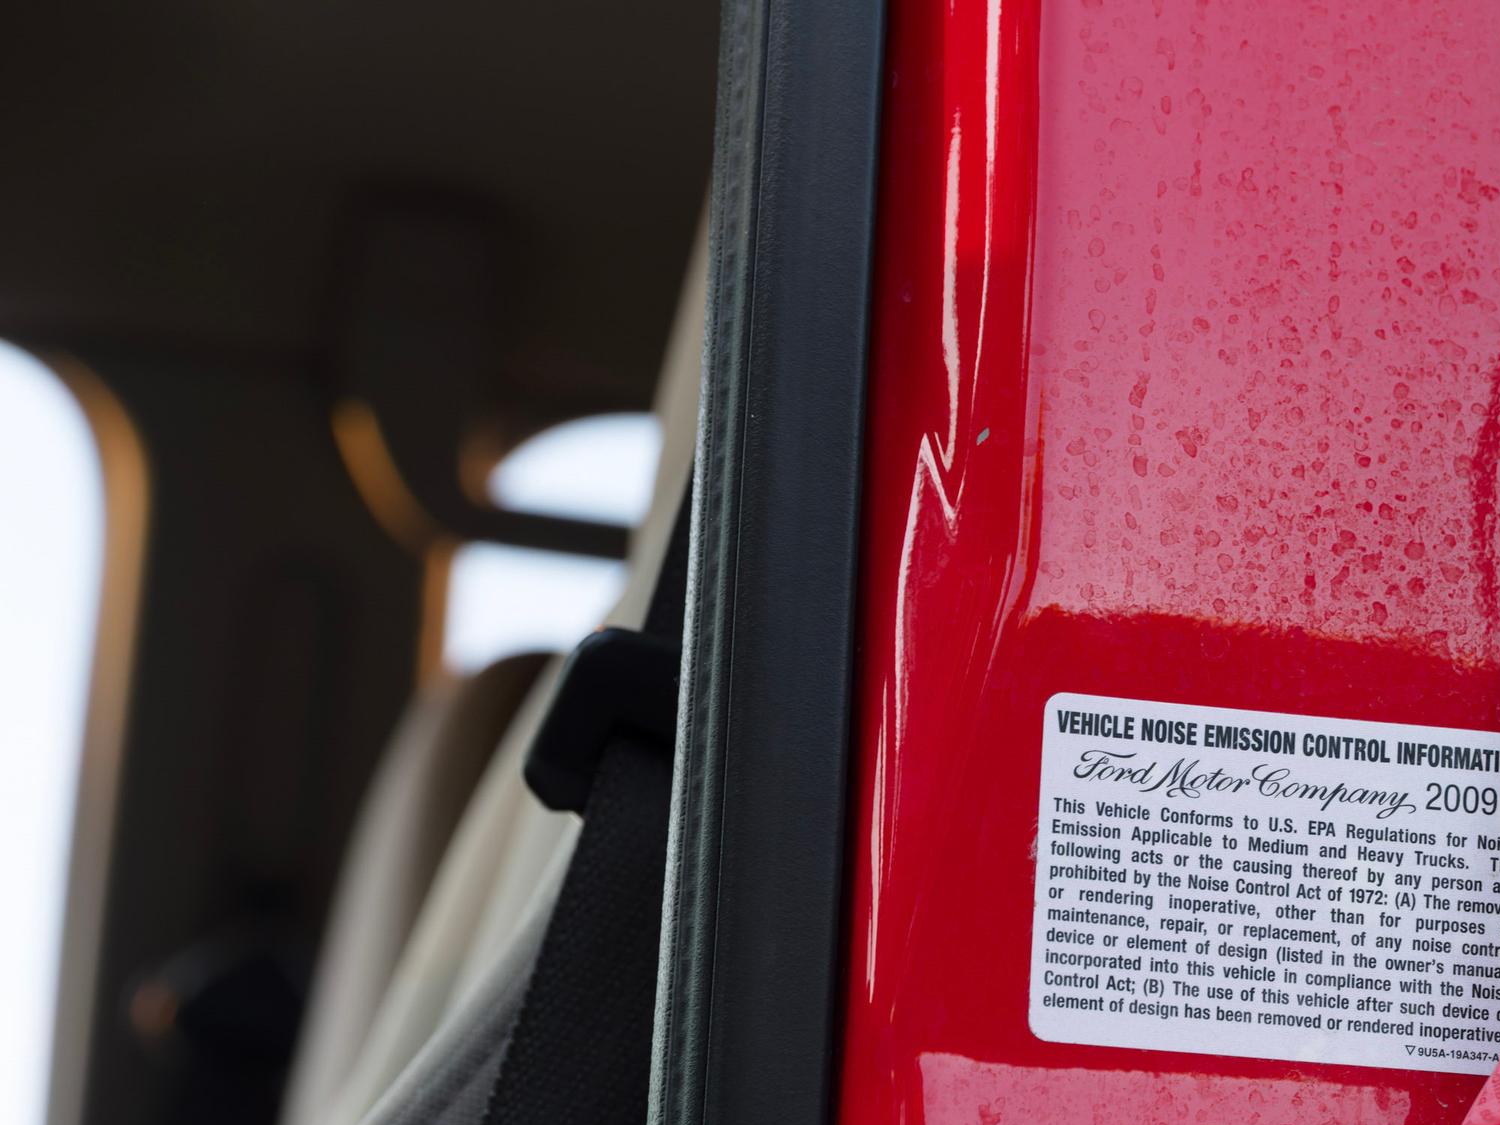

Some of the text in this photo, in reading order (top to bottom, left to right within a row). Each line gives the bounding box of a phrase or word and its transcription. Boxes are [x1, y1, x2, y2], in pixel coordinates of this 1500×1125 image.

[1057, 709, 1135, 740] VEHICLE
[1140, 717, 1198, 746] NOISE
[1203, 723, 1297, 755] EMISSION
[1302, 732, 1391, 764] CONTROL
[1073, 750, 1498, 820] Ford Motor Company 2009
[1051, 818, 1121, 840] Emission
[1130, 825, 1213, 848] Applicable
[1221, 834, 1238, 850] to
[1248, 836, 1309, 857] Medium
[1319, 844, 1347, 860] and
[1357, 845, 1404, 868] Heavy
[1414, 850, 1470, 870] Trucks.
[1053, 797, 1086, 815] This
[1095, 800, 1151, 821] Vehicle
[1160, 806, 1234, 829] Conforms
[1243, 814, 1259, 831] to
[1268, 816, 1298, 834] U.S.
[1307, 819, 1336, 838] EPA
[1345, 823, 1437, 846] Regulations
[1445, 831, 1469, 848] for
[1049, 864, 1127, 884] prohibited
[1133, 869, 1152, 889] by
[1156, 871, 1182, 889] the
[1187, 873, 1229, 893] Noise
[1235, 878, 1290, 898] Control
[1295, 883, 1322, 901] Act
[1327, 886, 1343, 902] of
[1348, 887, 1388, 906] 1972:
[1394, 891, 1417, 912] (A)
[1423, 893, 1451, 911] The
[1050, 840, 1121, 865] following
[1131, 849, 1164, 865] acts
[1173, 854, 1190, 868] or
[1198, 853, 1223, 871] the
[1232, 859, 1293, 880] causing
[1302, 862, 1358, 882] thereof
[1367, 867, 1385, 887] by
[1394, 873, 1422, 890] any
[1431, 876, 1483, 893] person
[1047, 907, 1149, 931] maintenance,
[1160, 917, 1208, 937] repair,
[1217, 922, 1234, 936] or
[1243, 923, 1341, 948] replacement,
[1350, 931, 1367, 947] of
[1375, 936, 1403, 953] any
[1412, 937, 1452, 954] noise
[1048, 886, 1065, 900] or
[1079, 888, 1154, 911] rendering
[1168, 894, 1261, 920] inoperative,
[1275, 904, 1317, 921] other
[1329, 907, 1365, 926] than
[1379, 911, 1402, 929] for
[1415, 917, 1486, 936] purposes
[1045, 948, 1142, 971] incorporated
[1149, 956, 1179, 975] into
[1186, 960, 1215, 977] this
[1222, 964, 1276, 983] vehicle
[1283, 968, 1298, 984] in
[1305, 973, 1392, 992] compliance
[1399, 978, 1433, 995] with
[1439, 981, 1464, 998] the
[1046, 927, 1095, 946] device
[1102, 934, 1119, 948] or
[1126, 934, 1188, 954] element
[1195, 939, 1211, 956] of
[1217, 941, 1268, 963] design
[1276, 946, 1324, 965] (listed
[1331, 950, 1345, 967] in
[1352, 952, 1377, 969] the
[1385, 958, 1445, 975] owner's
[1042, 992, 1105, 1012] element
[1108, 997, 1125, 1013] of
[1128, 999, 1179, 1020] design
[1184, 1003, 1211, 1020] has
[1216, 1005, 1252, 1024] been
[1257, 1012, 1322, 1029] removed
[1326, 1017, 1343, 1031] or
[1347, 1018, 1414, 1037] rendered
[1043, 970, 1100, 990] Control
[1105, 975, 1136, 995] Act;
[1143, 978, 1165, 998] (B)
[1172, 980, 1200, 998] The
[1206, 986, 1234, 1001] use
[1240, 987, 1256, 1002] of
[1261, 988, 1290, 1005] this
[1296, 992, 1350, 1010] vehicle
[1356, 996, 1394, 1013] after
[1399, 1000, 1435, 1017] such
[1442, 1002, 1490, 1021] device
[1417, 1047, 1500, 1062] 9U5A-19A347-A
